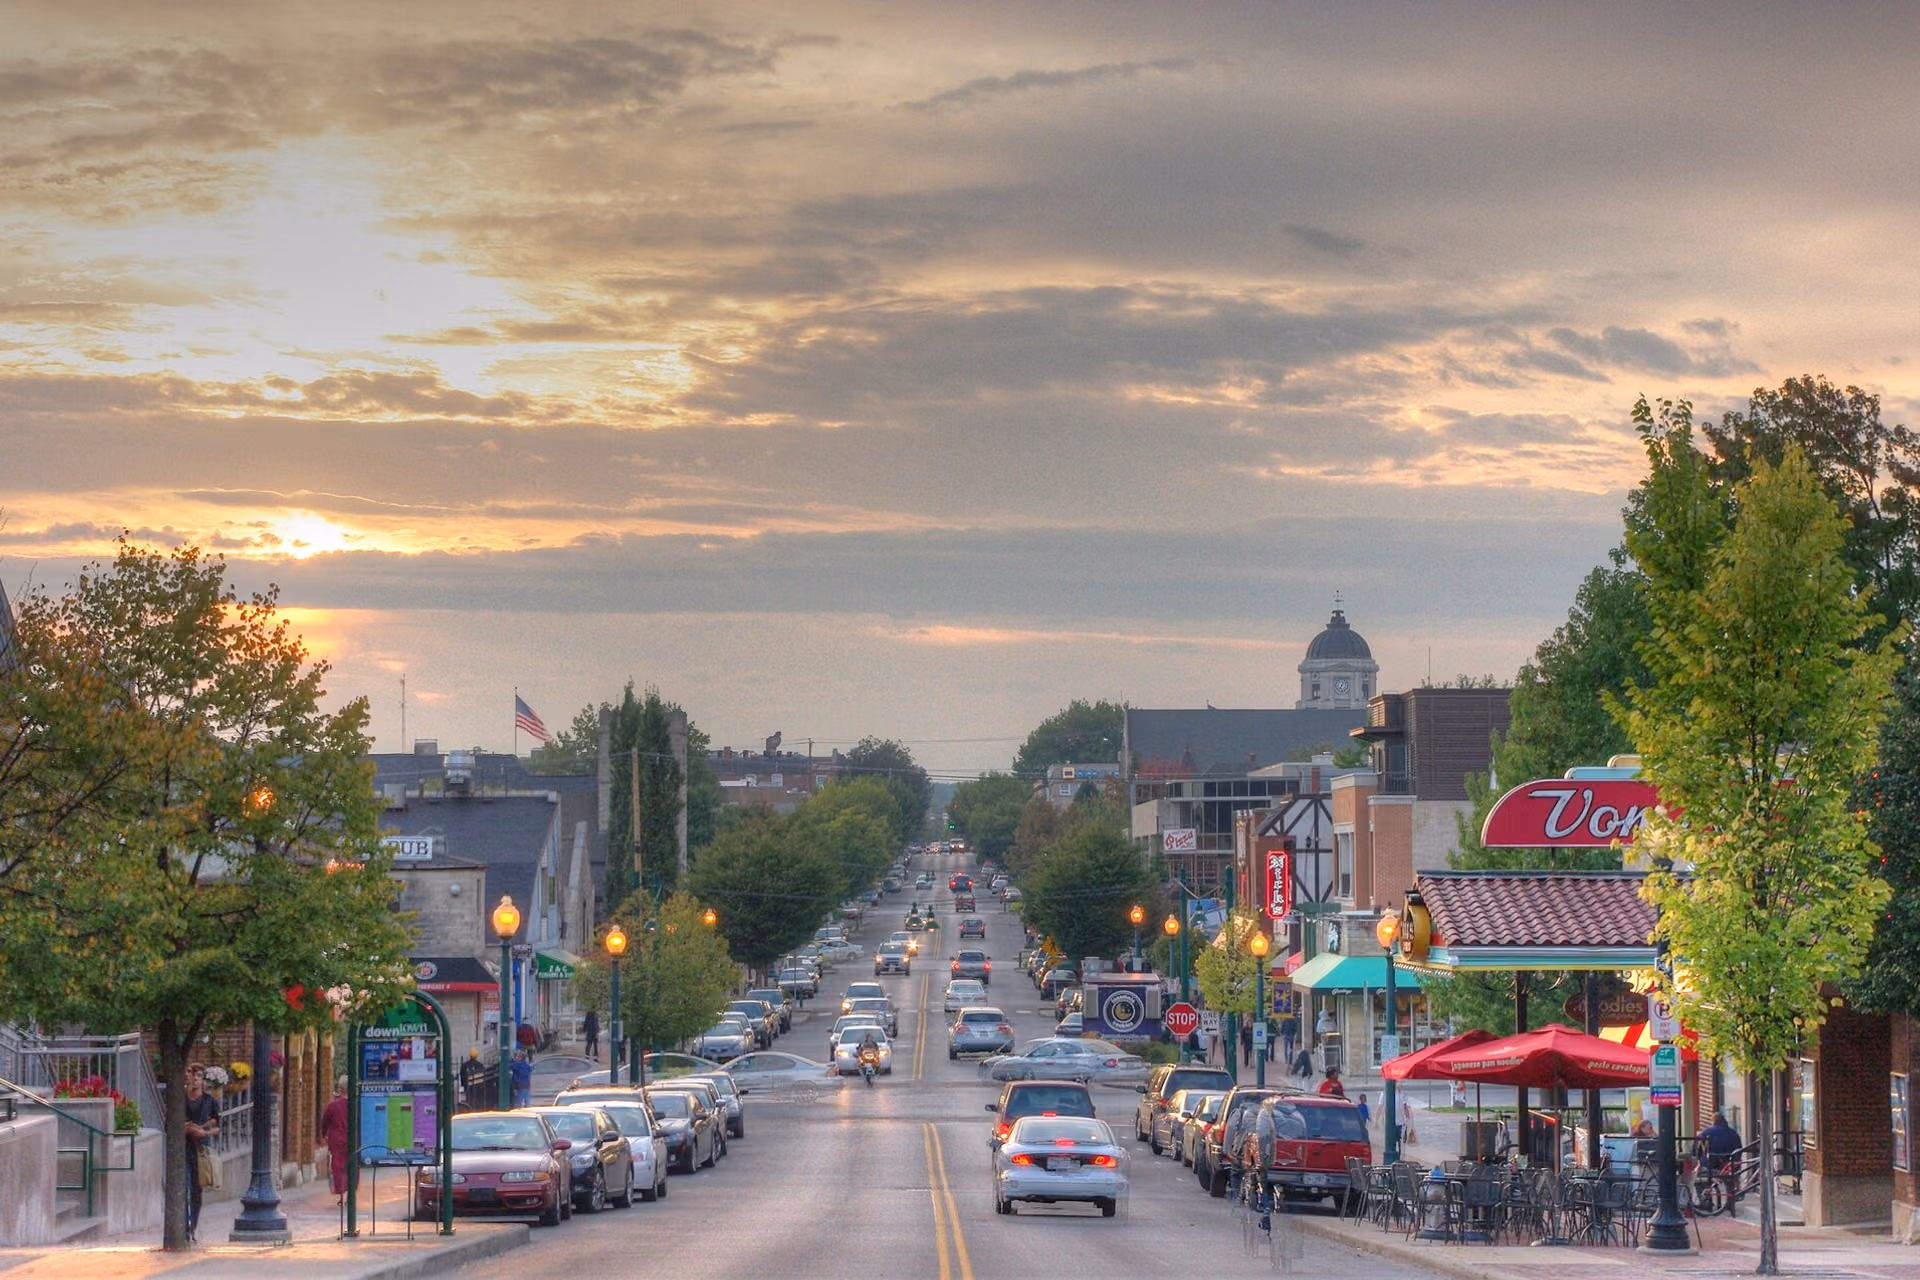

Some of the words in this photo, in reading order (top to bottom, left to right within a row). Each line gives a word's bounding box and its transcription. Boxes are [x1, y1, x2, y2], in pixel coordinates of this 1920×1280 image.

[1168, 1012, 1196, 1025] STOP
[1203, 1011, 1217, 1019] ONE
[365, 1023, 428, 1038] downtown
[1482, 1060, 1496, 1069] pan
